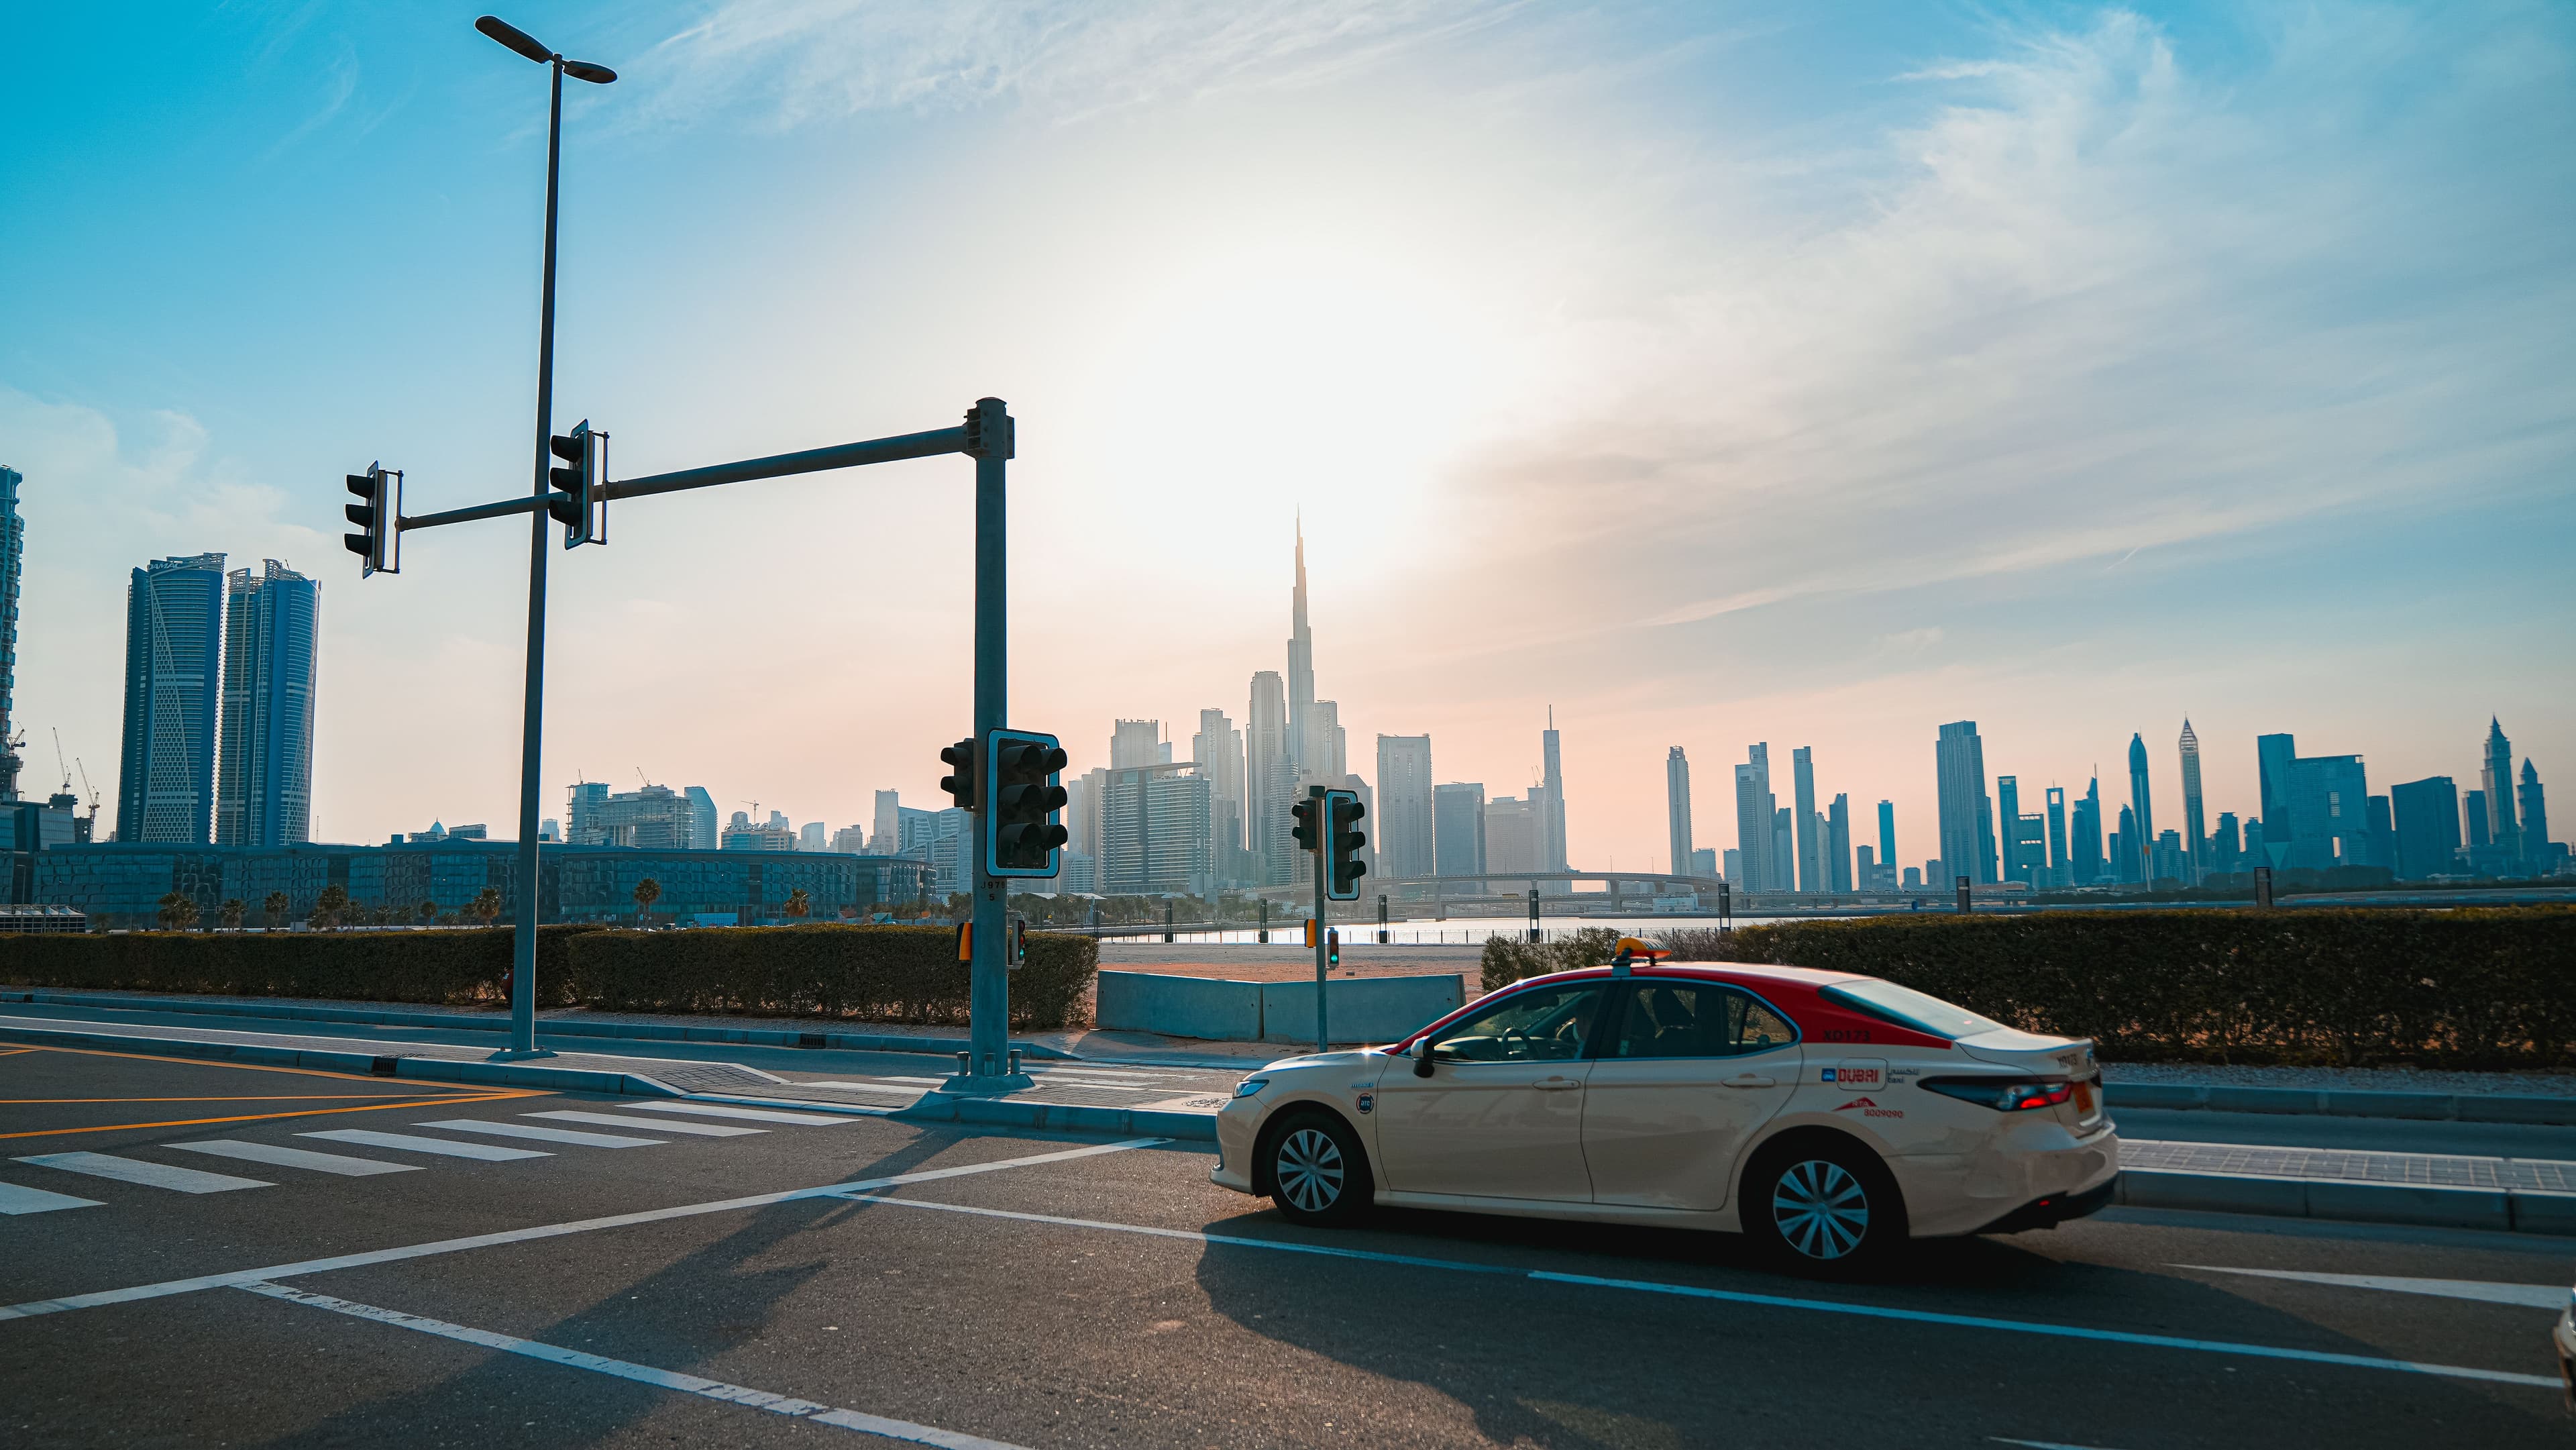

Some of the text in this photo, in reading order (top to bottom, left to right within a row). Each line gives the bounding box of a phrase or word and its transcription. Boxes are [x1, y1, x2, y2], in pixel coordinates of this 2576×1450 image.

[981, 880, 1005, 889] J979
[989, 893, 995, 901] 5
[1838, 1068, 1879, 1084] DUBAI
